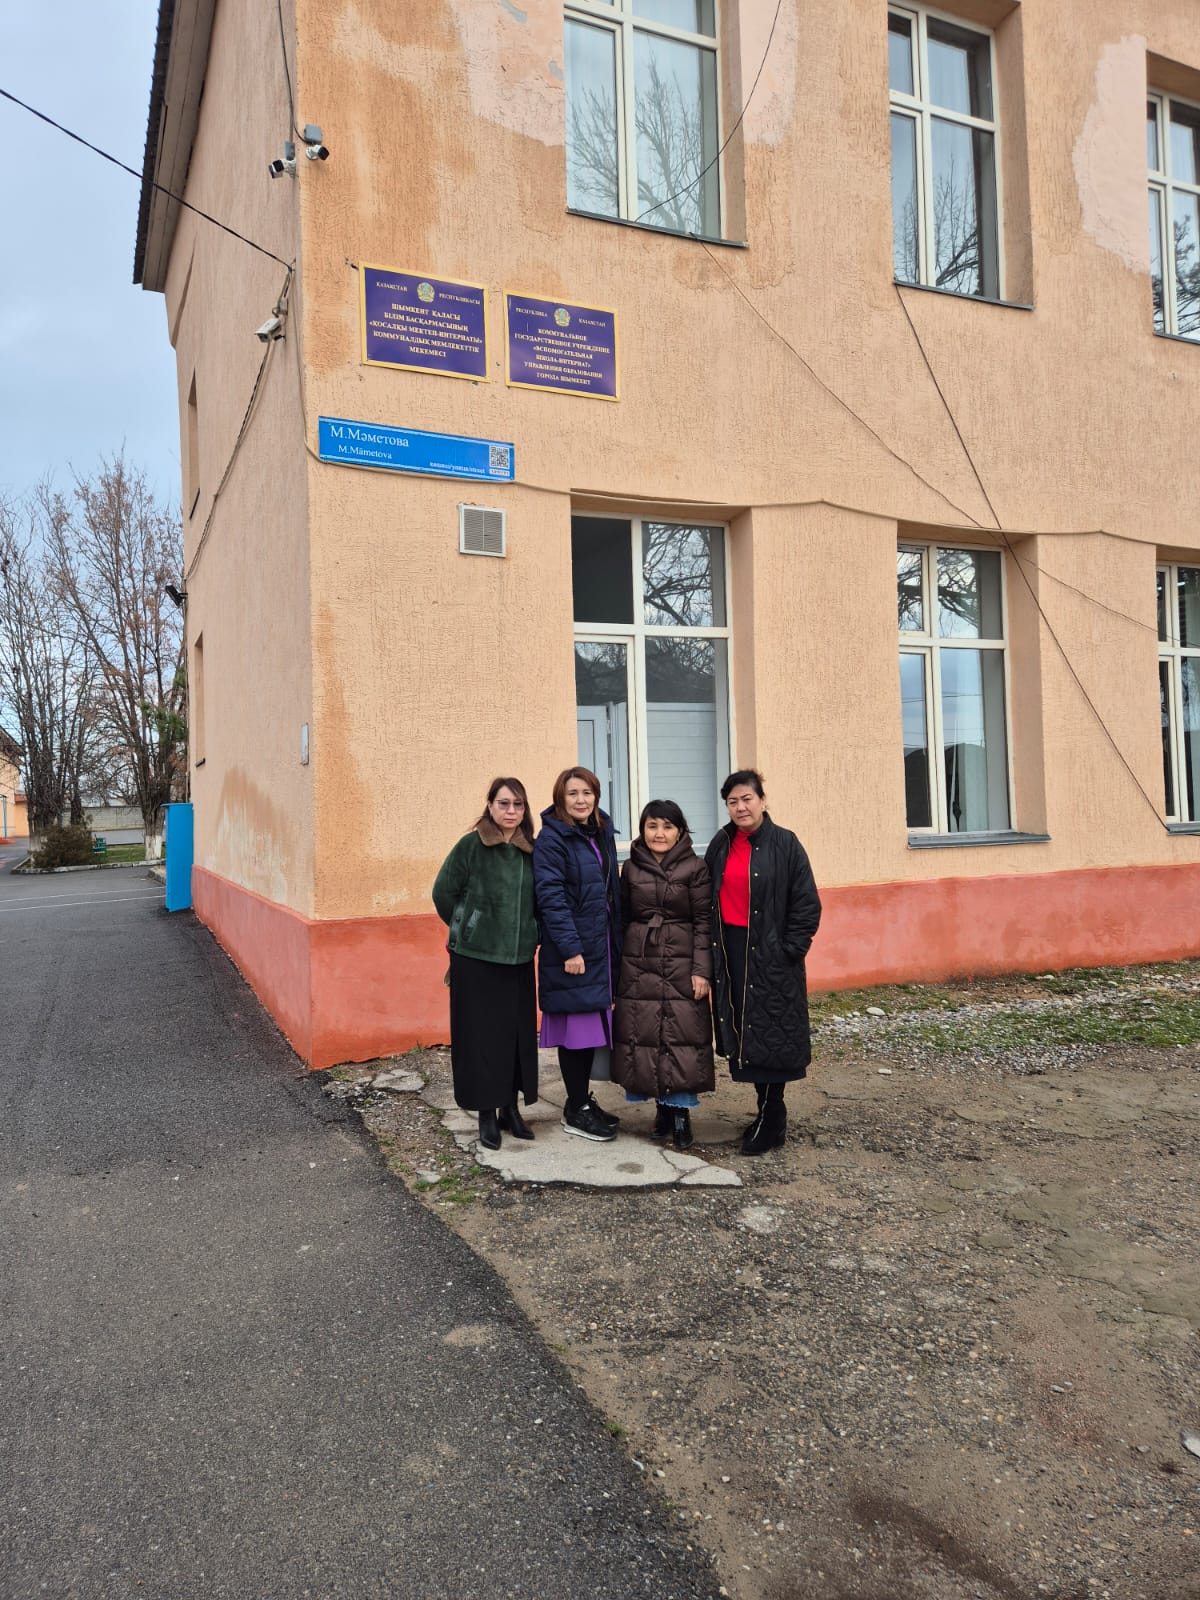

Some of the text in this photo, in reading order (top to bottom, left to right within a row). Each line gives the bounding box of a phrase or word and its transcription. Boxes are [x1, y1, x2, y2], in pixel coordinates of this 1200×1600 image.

[391, 303, 429, 315] ШЫМКЕНТ
[384, 312, 405, 321] БІЛІМ
[514, 333, 571, 348] ГОСУДАРСТВЕННОЕ
[538, 328, 587, 341] КОММУНАЛЬНОЕ
[330, 424, 410, 447] М.Мәметова
